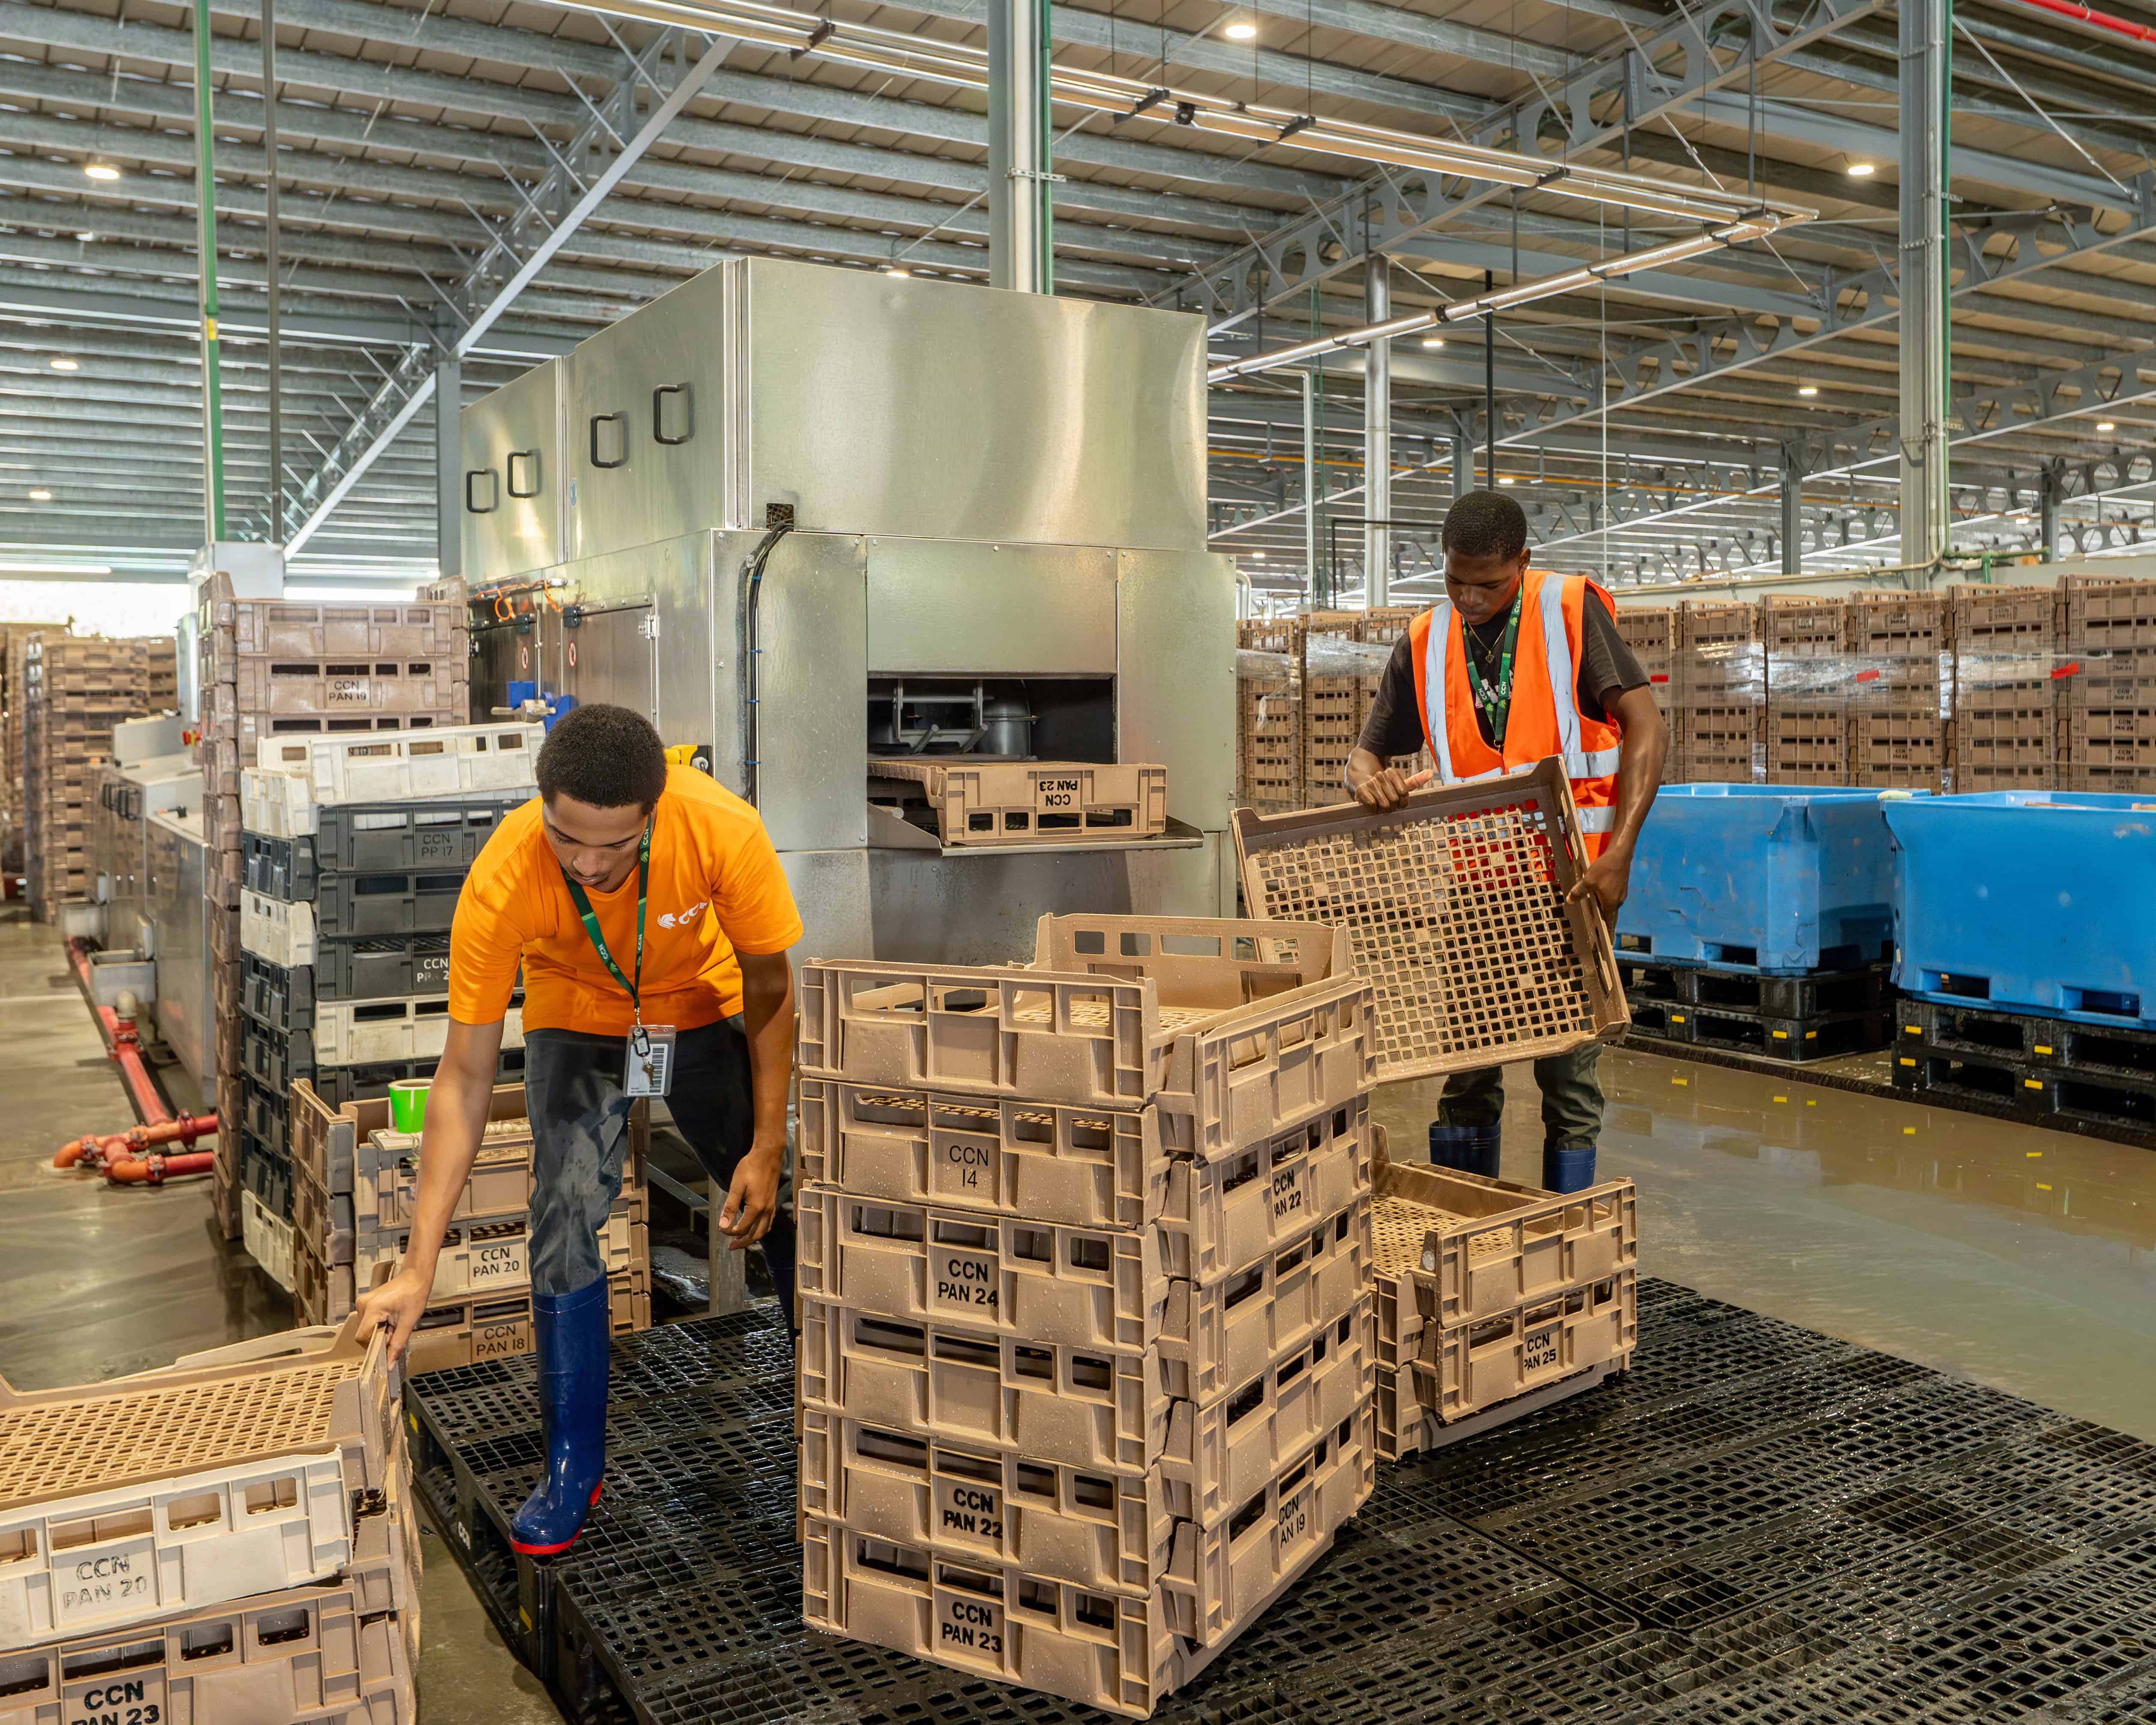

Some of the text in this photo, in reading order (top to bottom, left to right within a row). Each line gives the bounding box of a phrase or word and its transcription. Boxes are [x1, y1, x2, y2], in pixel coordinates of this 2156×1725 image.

[334, 680, 359, 690] CCN
[1478, 688, 1487, 700] CCN
[329, 690, 366, 701] PAN 19
[1039, 780, 1078, 791] PAN 23
[1045, 794, 1070, 806] CCN
[424, 834, 450, 844] CCN
[422, 846, 453, 856] PP 17
[598, 943, 608, 959] CCN
[424, 958, 448, 969] CCN
[443, 970, 449, 980] 2
[950, 1145, 988, 1166] CCN
[962, 1169, 977, 1188] 14
[1274, 1169, 1295, 1196] CCN
[1289, 1191, 1301, 1210] 22
[481, 1247, 510, 1262] CCN
[473, 1260, 519, 1277] PAN 20
[948, 1259, 988, 1283] CCN
[938, 1281, 998, 1307] PAN 24
[484, 1324, 516, 1340] CCN
[477, 1339, 525, 1356] PAN 18
[1528, 1332, 1550, 1353] CCN
[1543, 1348, 1556, 1365] 25
[954, 1488, 993, 1514] CCN
[1279, 1493, 1298, 1526] CCN
[944, 1509, 1003, 1539] PAN 22
[1297, 1513, 1304, 1534] 19
[76, 1553, 130, 1581] CCN
[64, 1576, 147, 1609] PAN 20
[952, 1602, 992, 1628] CCN
[942, 1622, 1002, 1653] PAN 23
[84, 1680, 143, 1710] CCN
[126, 1704, 160, 1725] 23
